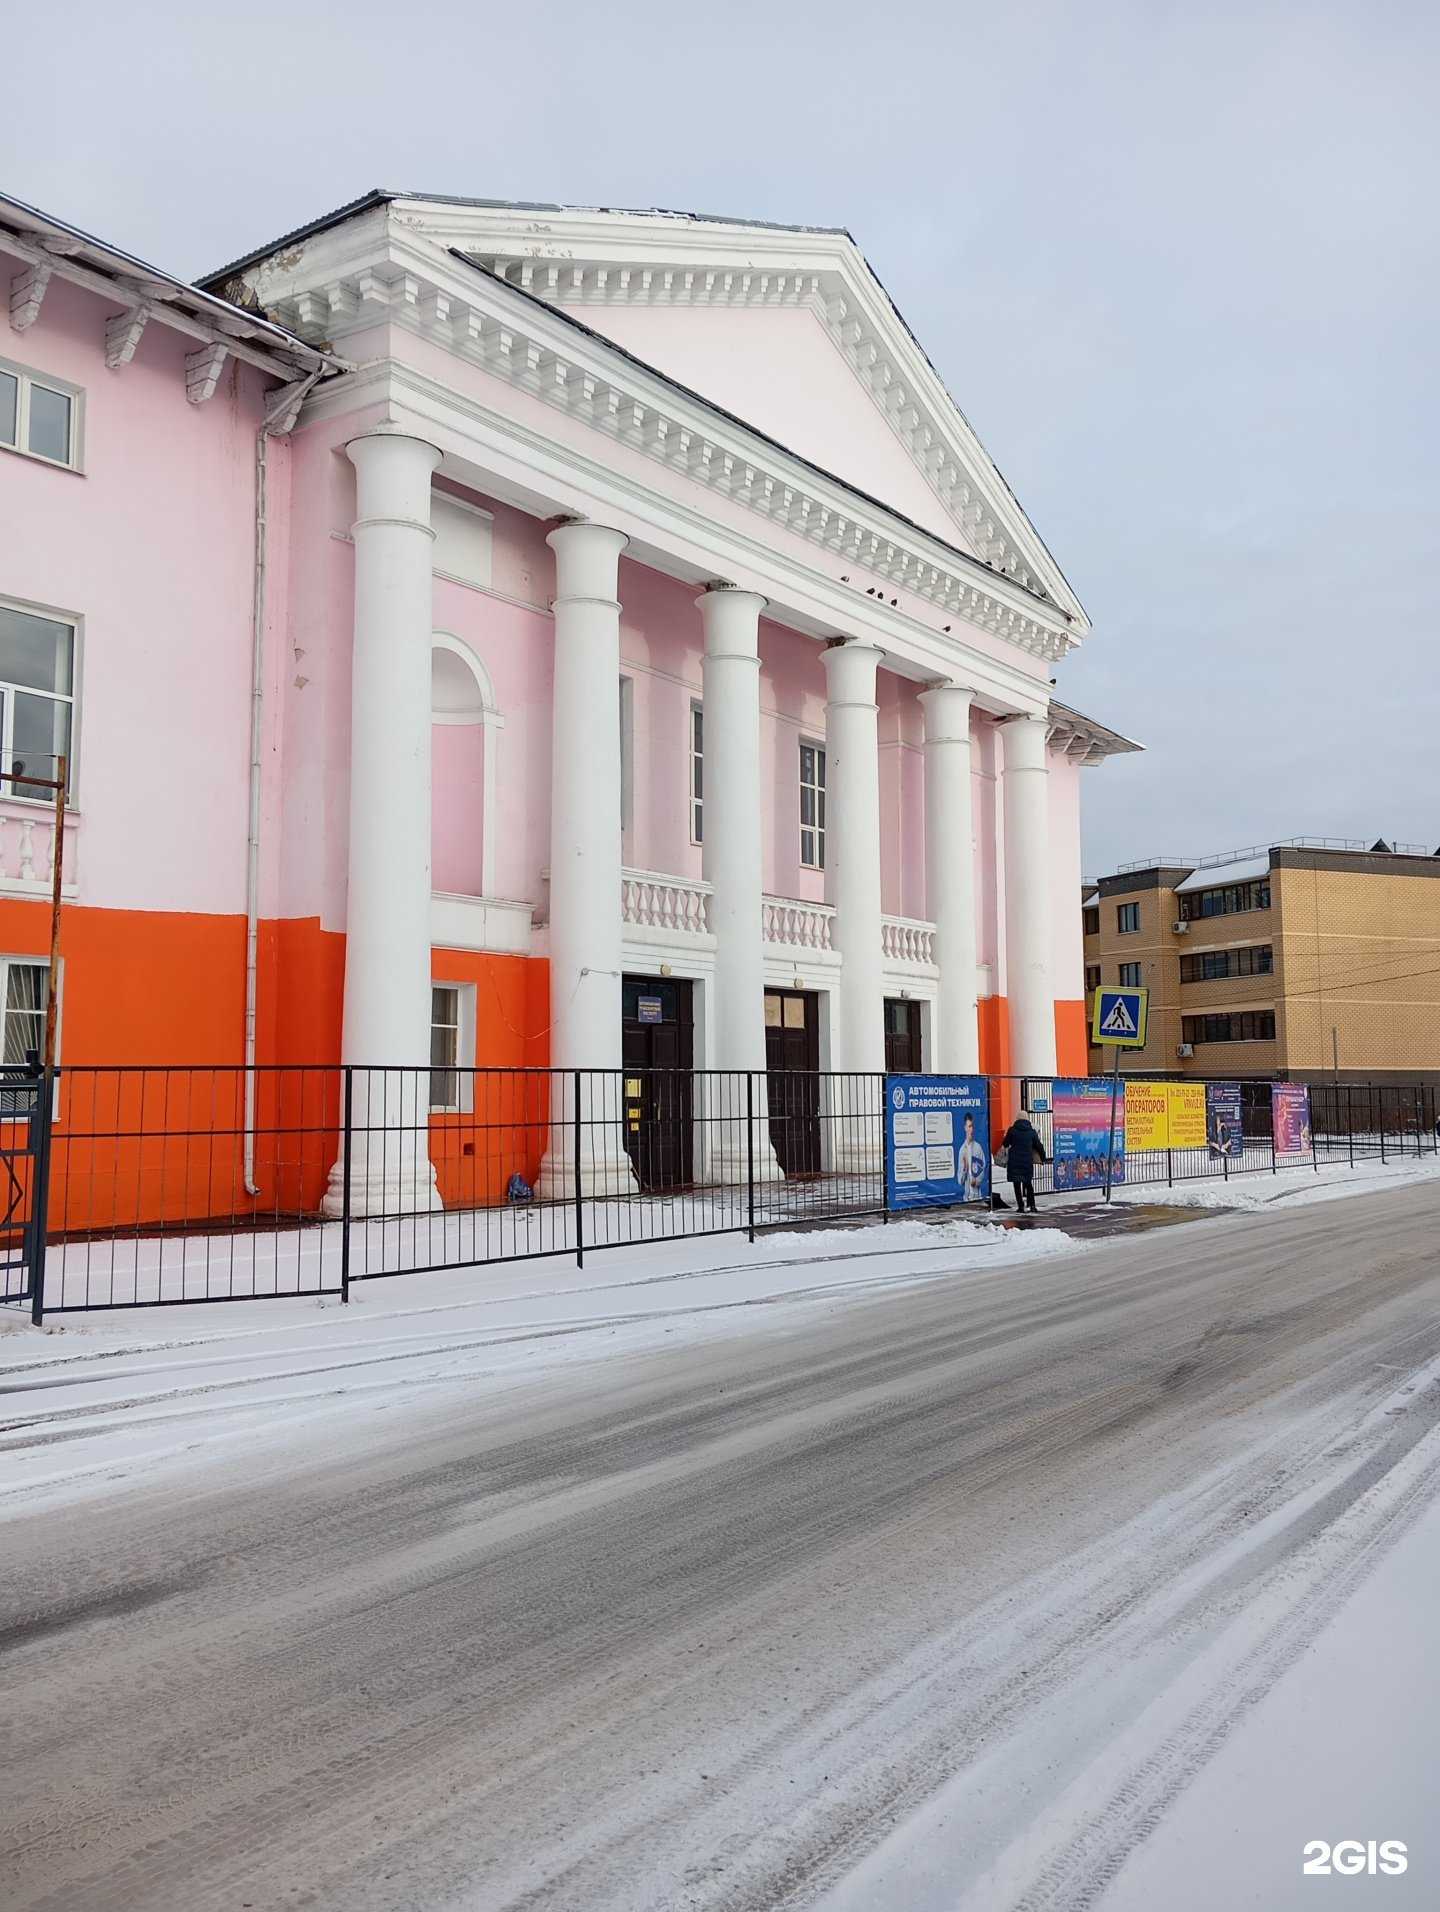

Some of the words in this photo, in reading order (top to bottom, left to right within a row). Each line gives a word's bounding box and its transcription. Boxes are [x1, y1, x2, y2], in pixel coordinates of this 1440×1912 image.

[908, 1085, 970, 1096] АВТОМОБИЛЬНЫЙ
[1126, 1085, 1152, 1097] ОБУЧЕНИЕ
[908, 1097, 947, 1108] ПРАВОВОЙ
[947, 1098, 981, 1108] ТЕХНИКУМ
[1126, 1099, 1165, 1114] ОПЕРАТОРОВ
